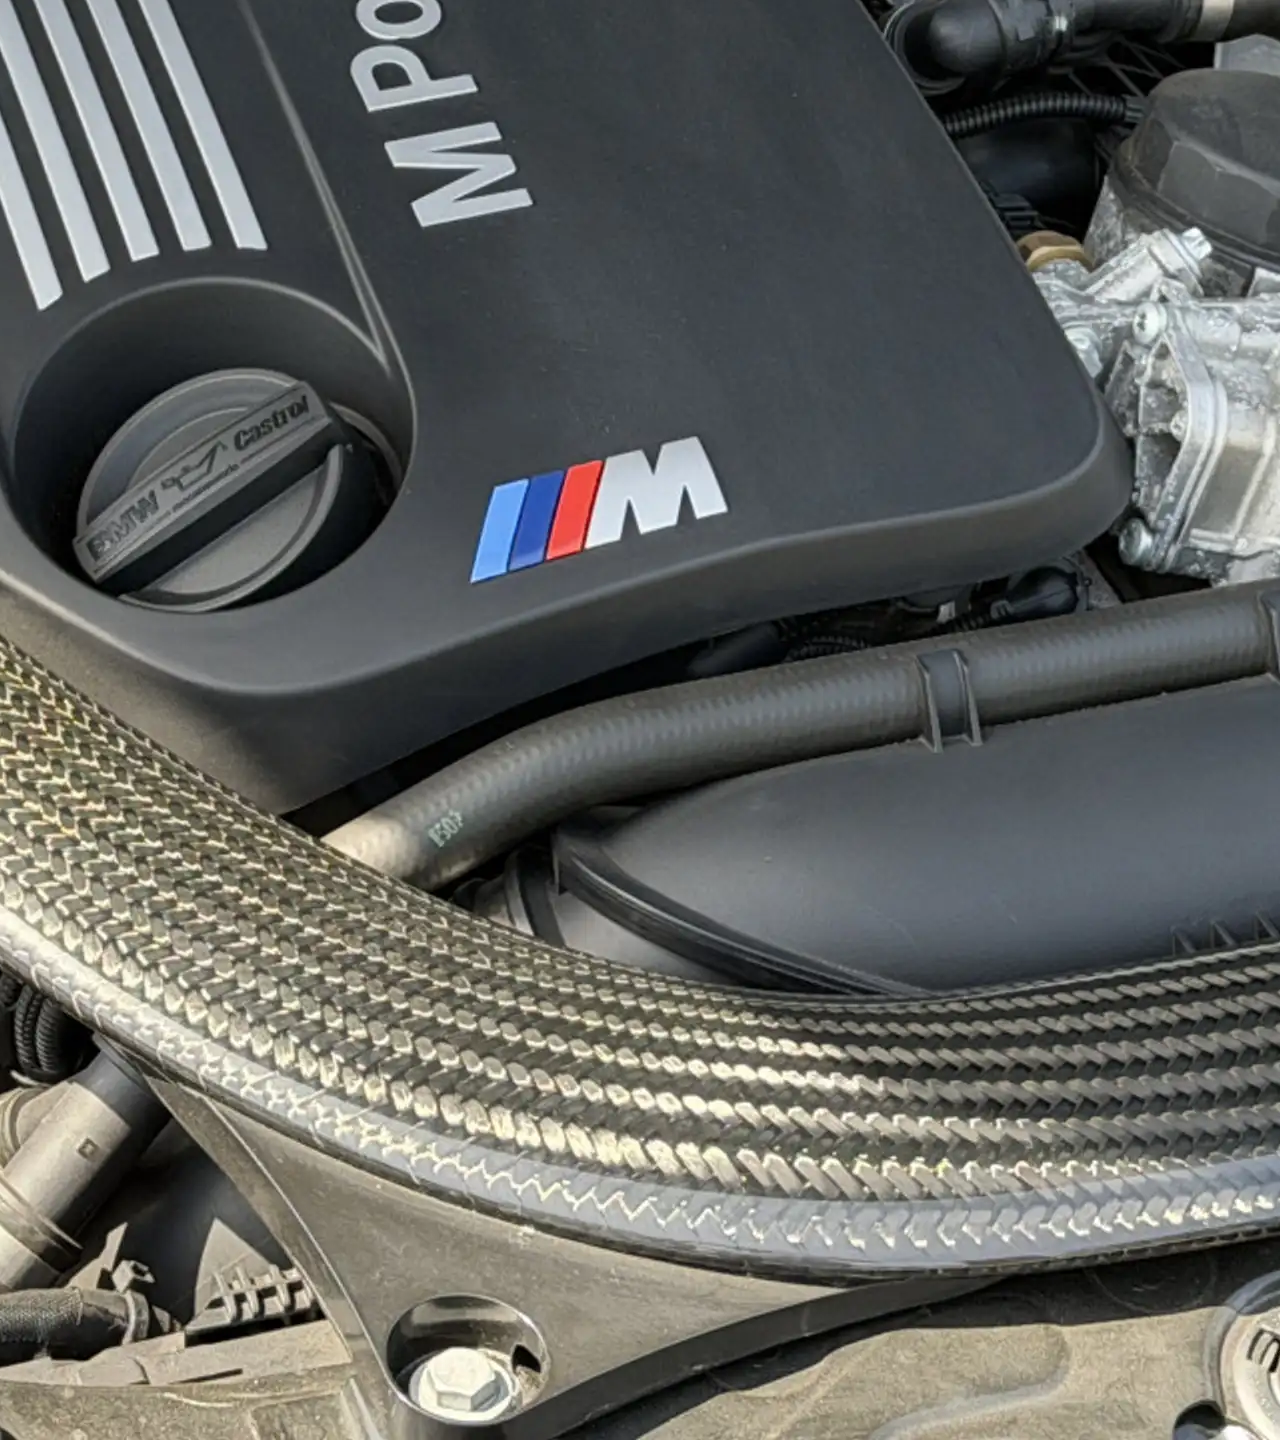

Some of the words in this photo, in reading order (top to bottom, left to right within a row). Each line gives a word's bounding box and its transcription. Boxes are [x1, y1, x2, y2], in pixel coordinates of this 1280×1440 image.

[383, 121, 533, 228] M
[87, 490, 160, 562] BMW
[234, 395, 309, 452] Castrol
